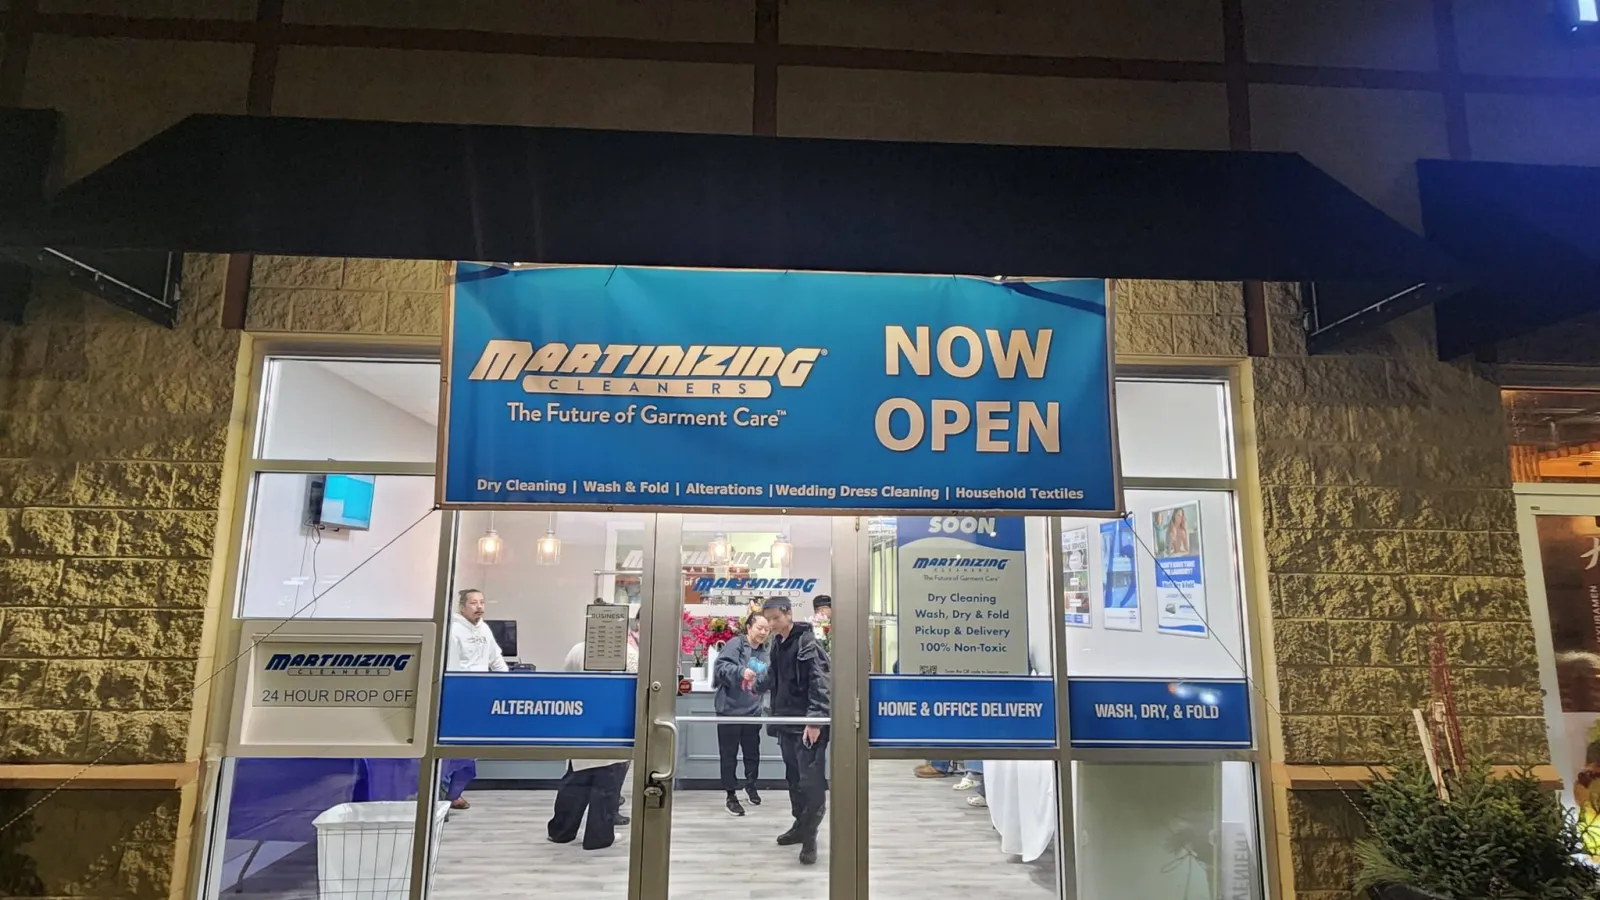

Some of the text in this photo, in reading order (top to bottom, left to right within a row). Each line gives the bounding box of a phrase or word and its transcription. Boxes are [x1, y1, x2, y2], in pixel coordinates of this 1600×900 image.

[884, 325, 1053, 379] NOW
[549, 378, 748, 395] CLEANERS
[507, 402, 542, 422] The
[547, 403, 611, 424] Future
[615, 404, 637, 424] of
[641, 405, 728, 426] Garment
[874, 397, 1060, 453] OPEN
[477, 478, 502, 493] Dry
[506, 479, 567, 495] Cleaning
[583, 480, 622, 493] Wash
[625, 481, 636, 493] &
[640, 481, 670, 494] Fold
[685, 482, 763, 496] Alterations
[775, 484, 836, 499] Wedding
[840, 485, 878, 498] Dress
[881, 486, 940, 500] Cleaning
[956, 486, 1026, 500] Household
[1030, 488, 1084, 500] Textiles
[928, 516, 996, 535] SOON
[913, 557, 1009, 570] MARTINIZING
[692, 577, 817, 593] MARTINIZING
[928, 593, 997, 606] Dry Cleaning
[915, 609, 1010, 621] Wash, Dry & Fold
[915, 626, 1011, 638] Pickup & Delivery
[920, 642, 1007, 653] 100% Non-Toxic
[265, 653, 412, 672] MARTINIZING
[262, 689, 413, 702] 24 HOUR DROP OFF
[491, 700, 583, 715] ALTERATIONS
[878, 701, 1043, 718] HOME & OFFICE DELIVERY
[1094, 703, 1220, 720] WASH, DRY, & FOLD
